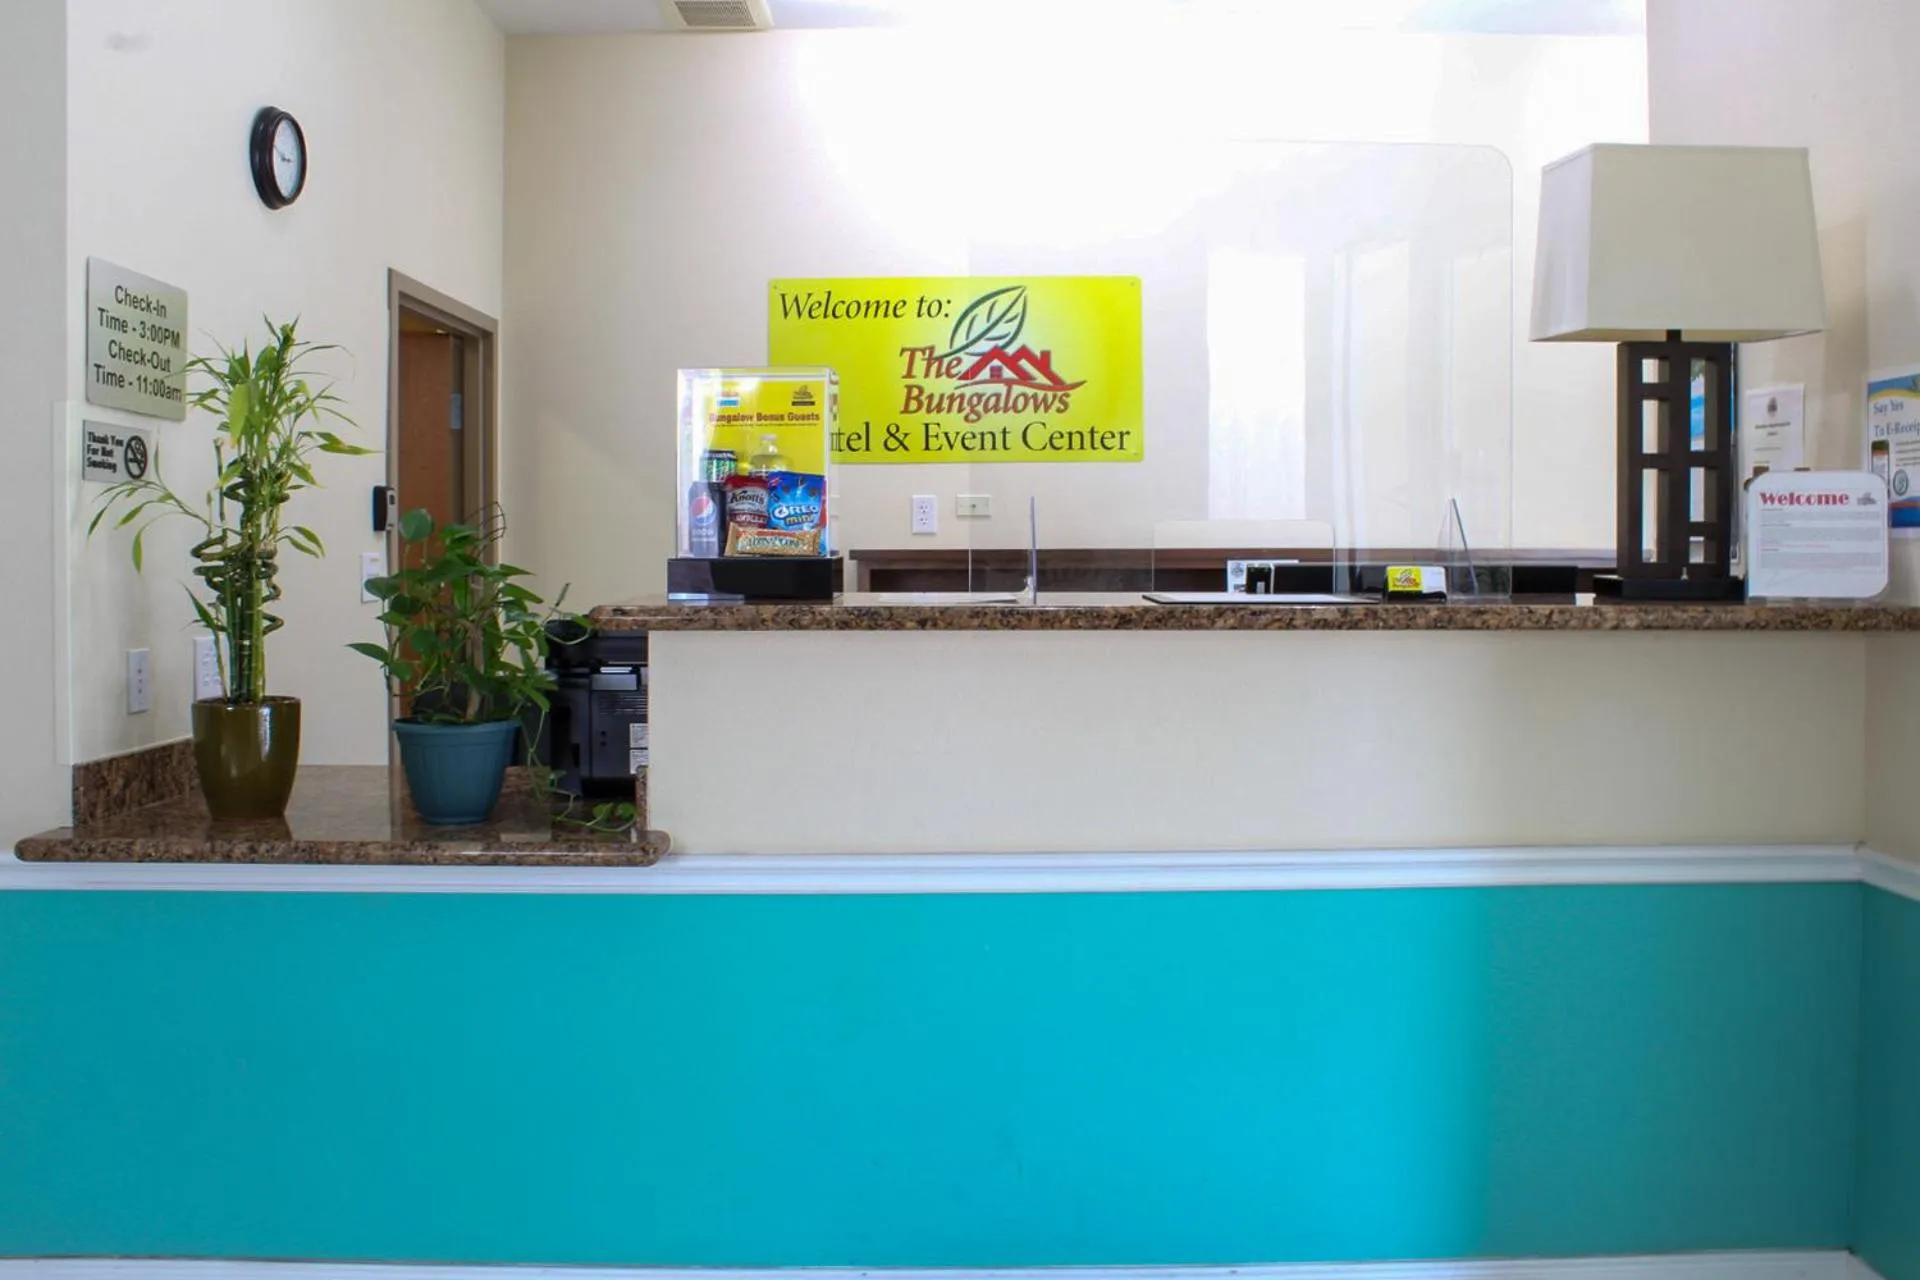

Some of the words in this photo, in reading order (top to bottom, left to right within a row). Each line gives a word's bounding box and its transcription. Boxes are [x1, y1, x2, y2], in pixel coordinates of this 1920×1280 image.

[114, 285, 167, 319] Check-In
[779, 291, 906, 320] Welcome
[916, 295, 952, 319] to:
[97, 307, 128, 334] Time
[138, 320, 181, 349] 3:00PM
[108, 340, 171, 373] Check-Out
[900, 345, 962, 380] The
[93, 364, 125, 389] Time
[136, 374, 182, 402] 11:00am
[756, 412, 785, 422] Bonus
[788, 412, 820, 422] Guests
[900, 384, 1071, 424] Bungalows
[882, 423, 910, 453] &
[924, 423, 1010, 453] Event
[1021, 421, 1131, 453] Center
[1760, 491, 1850, 506] Welcome
